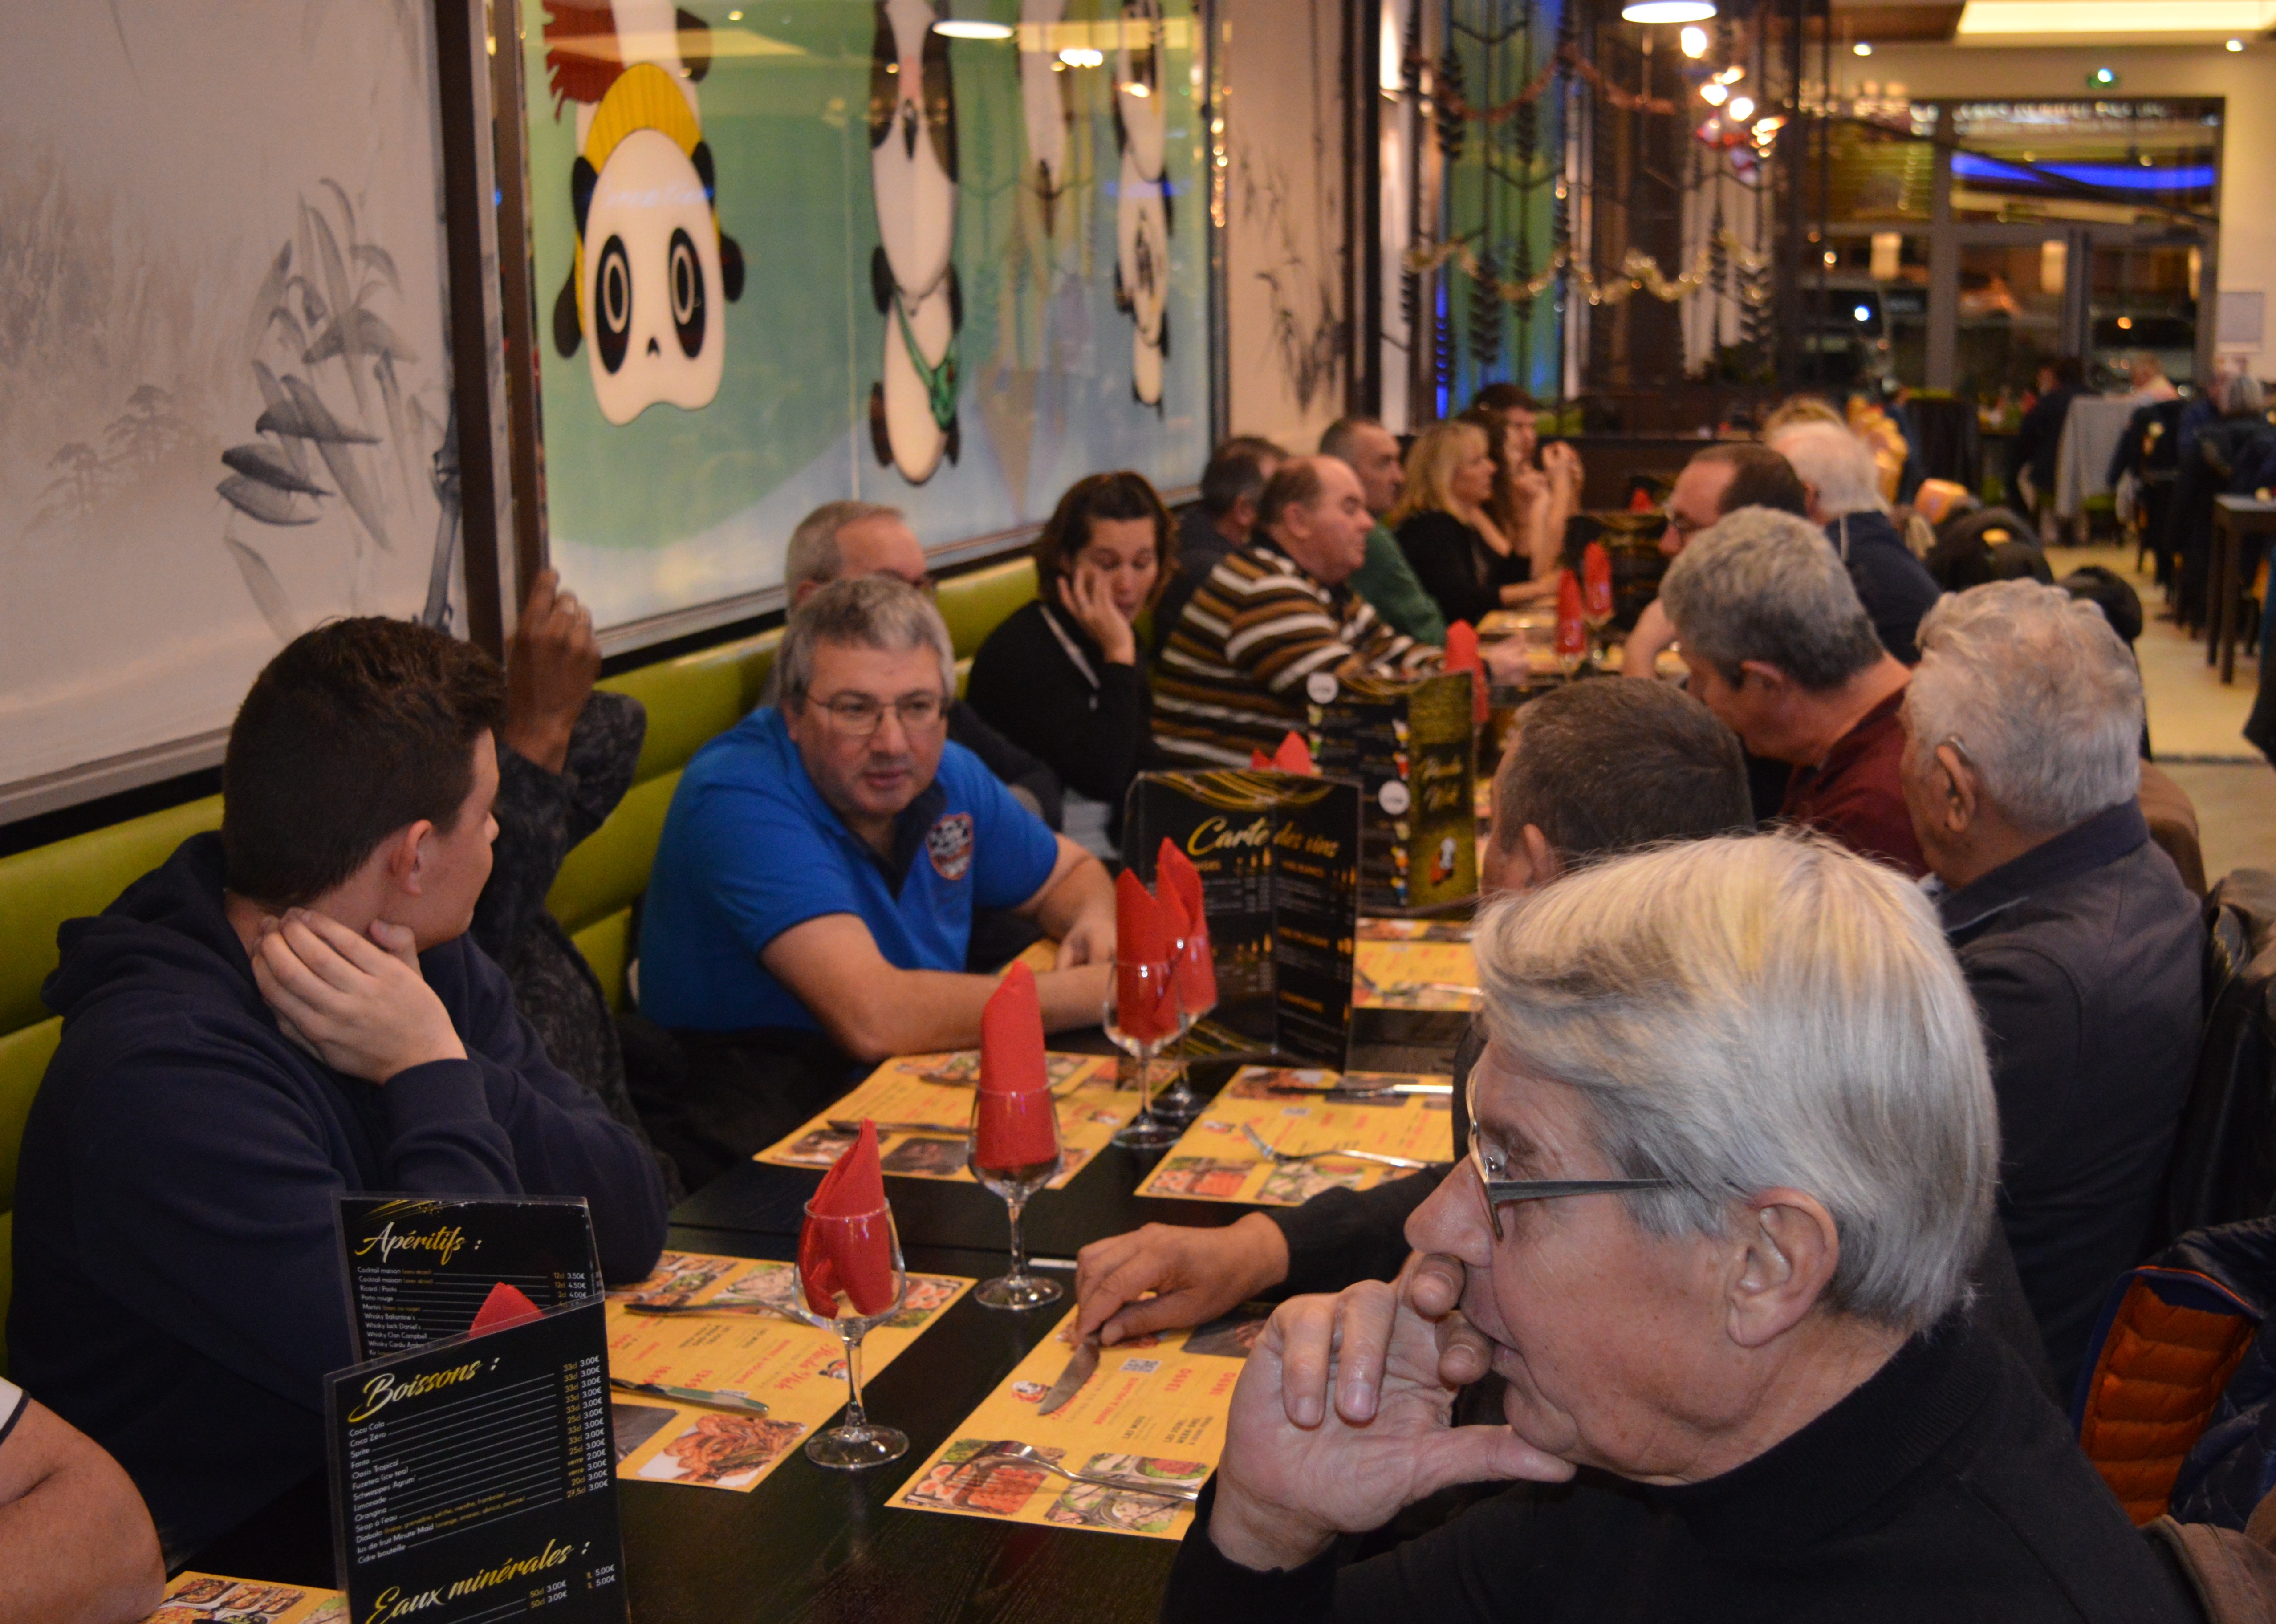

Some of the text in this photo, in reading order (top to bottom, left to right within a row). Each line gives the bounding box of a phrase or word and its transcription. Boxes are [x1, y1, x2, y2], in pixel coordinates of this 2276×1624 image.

[1187, 815, 1270, 856] Carte
[354, 1222, 467, 1266] Apéritifs
[347, 1360, 484, 1423] Boissons
[350, 1355, 600, 1437] Coca Cola 33cl 3.00€
[350, 1438, 368, 1447] Coca
[564, 1372, 578, 1382] 33cl
[581, 1365, 601, 1377] 3.00€
[351, 1376, 601, 1458] Sprite 33cl 3.00€
[351, 1386, 602, 1469] Fanta 33cl 3.00€
[567, 1414, 581, 1424] 25cl
[584, 1407, 603, 1419] 3.00€
[352, 1397, 602, 1479] Oasis Tropical 33cl 3.00€
[353, 1485, 391, 1501] Schweppes
[567, 1425, 581, 1434] 33cl
[585, 1417, 604, 1429] 3.00€
[354, 1428, 605, 1511] Limonade 33cl 3.00€
[355, 1438, 606, 1521] Orangina 25cl 3.00€
[356, 1523, 373, 1532] Sirop
[567, 1458, 584, 1466] verre
[587, 1448, 606, 1460] 2.00€
[356, 1530, 383, 1543] Diabolo
[569, 1468, 584, 1476] verre
[587, 1459, 607, 1470] 3.00€
[393, 1530, 416, 1541] Minute
[417, 1523, 434, 1534] Maid
[572, 1476, 585, 1486] 20cl
[588, 1469, 608, 1481] 3.00€
[358, 1554, 376, 1564] Cidre
[377, 1543, 406, 1558] bouteille
[589, 1479, 609, 1491] 3.00€
[365, 1585, 446, 1624] Eaux
[448, 1539, 574, 1600] minérales
[530, 1587, 544, 1598] 50cl
[547, 1580, 567, 1592] 3.00€
[595, 1564, 614, 1576] 5.00€
[531, 1597, 545, 1608] 50cl
[548, 1590, 568, 1603] 3.00€
[596, 1574, 615, 1586] 5.00€
